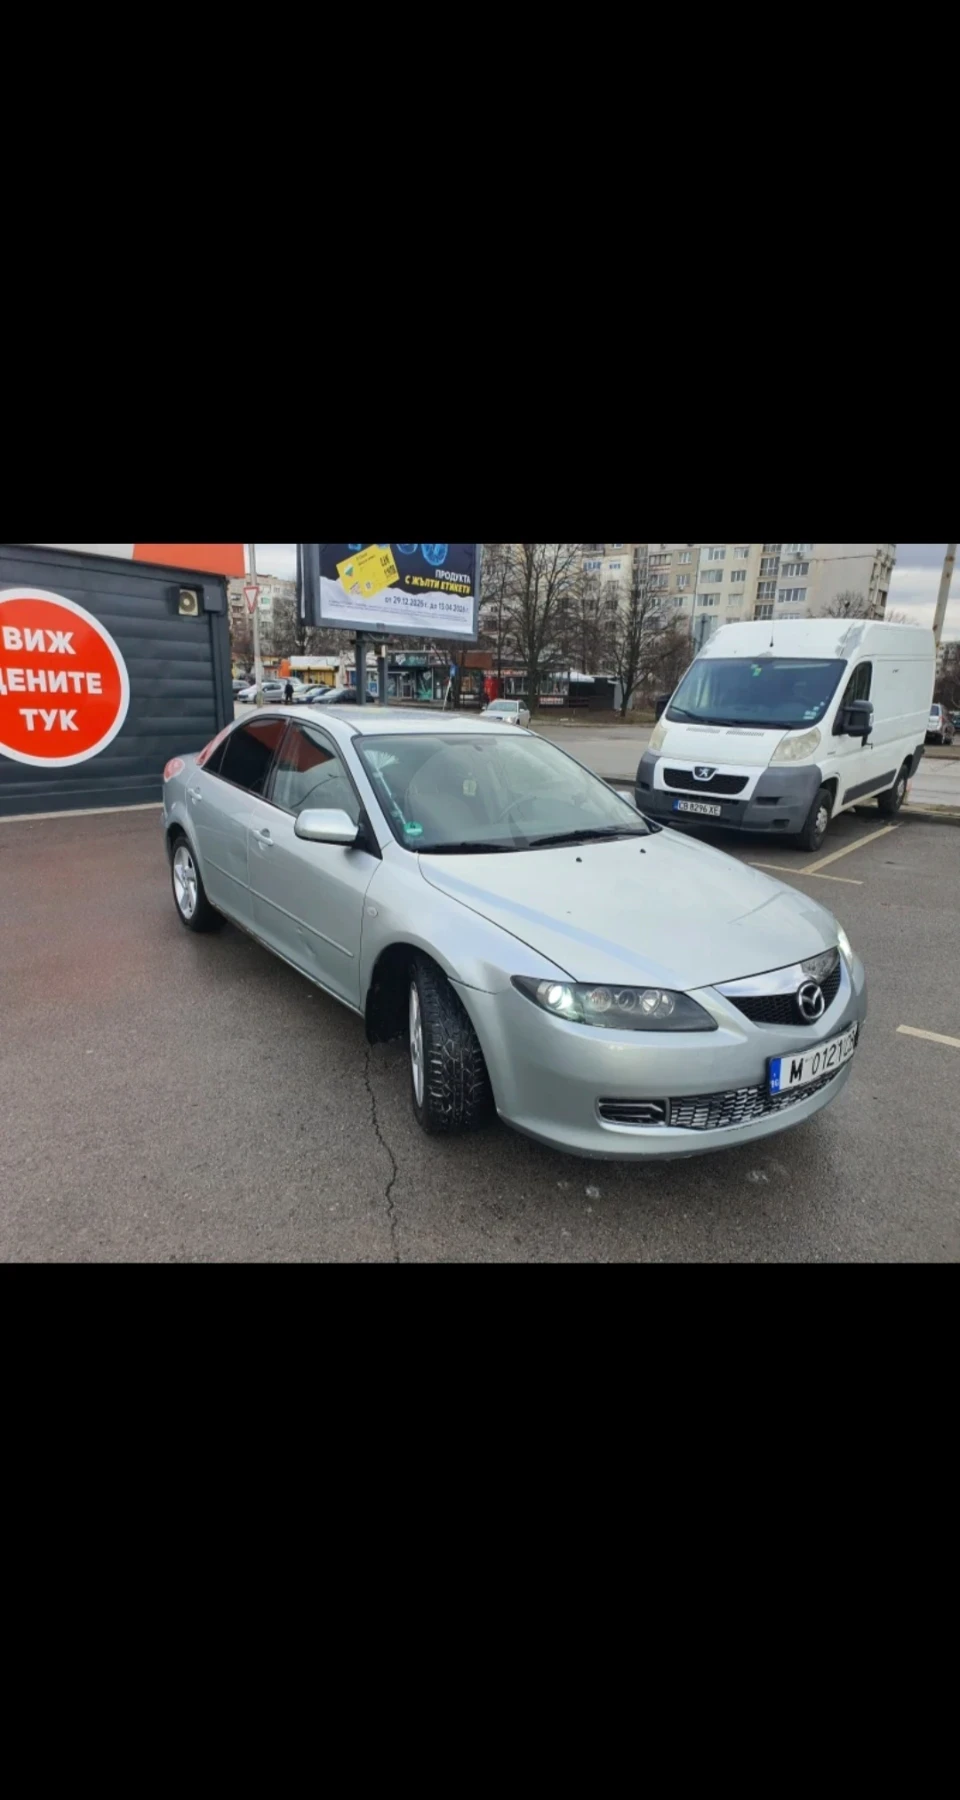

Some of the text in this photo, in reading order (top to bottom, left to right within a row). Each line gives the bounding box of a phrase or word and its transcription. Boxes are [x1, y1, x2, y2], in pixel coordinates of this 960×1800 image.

[411, 576, 440, 589] ЖЪЛТИ
[435, 569, 471, 584] ПРОДУКТА
[2, 625, 76, 654] ВИЖ
[19, 708, 79, 731] ТУК
[689, 803, 708, 813] 8296
[789, 1058, 804, 1084] M
